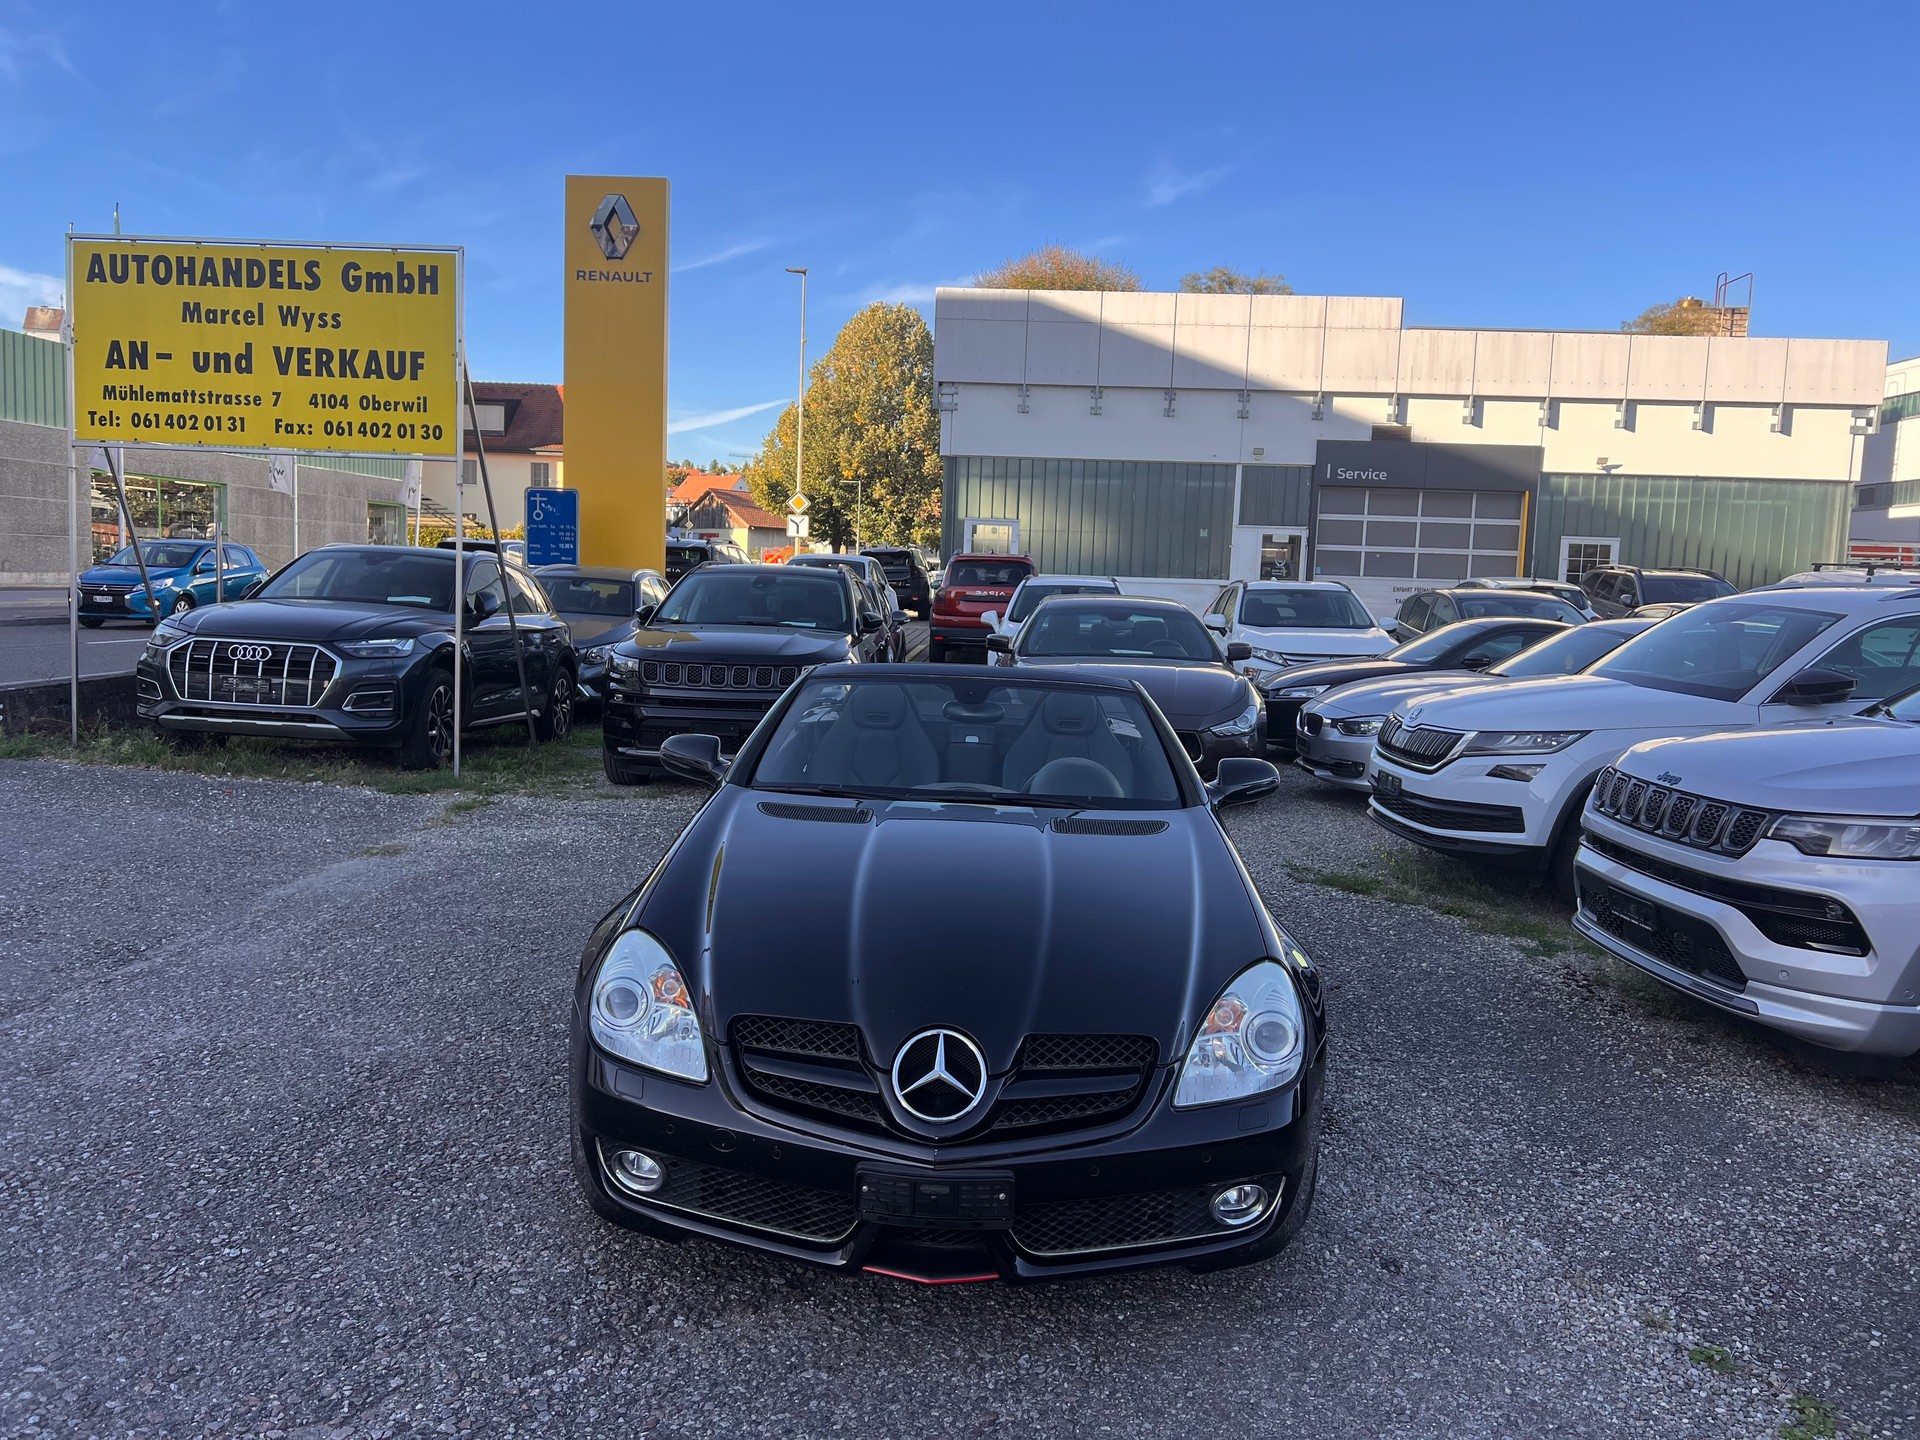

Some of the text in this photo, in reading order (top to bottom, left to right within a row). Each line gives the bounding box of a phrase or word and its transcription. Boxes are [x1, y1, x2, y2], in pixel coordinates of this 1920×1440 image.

[86, 252, 439, 296] AUTOHANDELS GmbH
[576, 270, 653, 283] RENAULT
[181, 301, 342, 333] Marcel Wyss
[192, 342, 253, 375] und
[273, 345, 425, 381] VERKAUF
[102, 384, 428, 414] Mühlemattstrasse 7 4104 Oberwil
[87, 410, 121, 428] Tel:
[274, 418, 313, 437] Fax:
[1337, 467, 1388, 480] Service
[1656, 770, 1682, 786] Jeep
